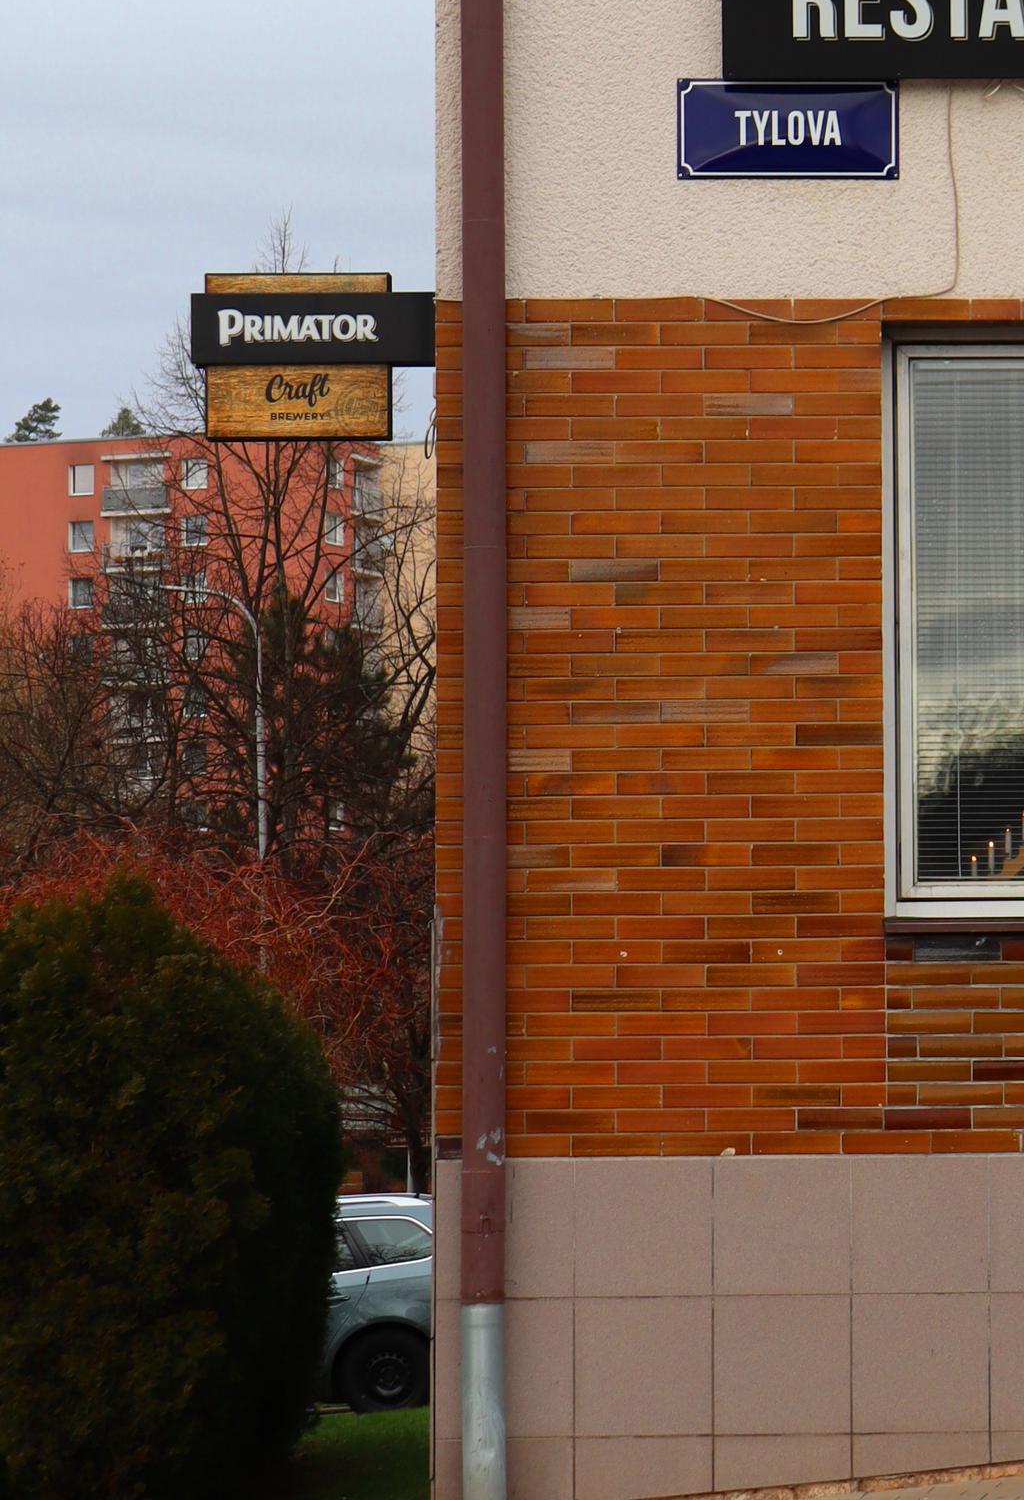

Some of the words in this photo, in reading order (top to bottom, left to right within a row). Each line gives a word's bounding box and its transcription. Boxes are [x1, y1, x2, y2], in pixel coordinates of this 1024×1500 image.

[735, 110, 842, 147] TYLOVA
[217, 308, 379, 347] PRIMATOR
[265, 373, 330, 408] Craft
[270, 412, 326, 421] BREWERY
